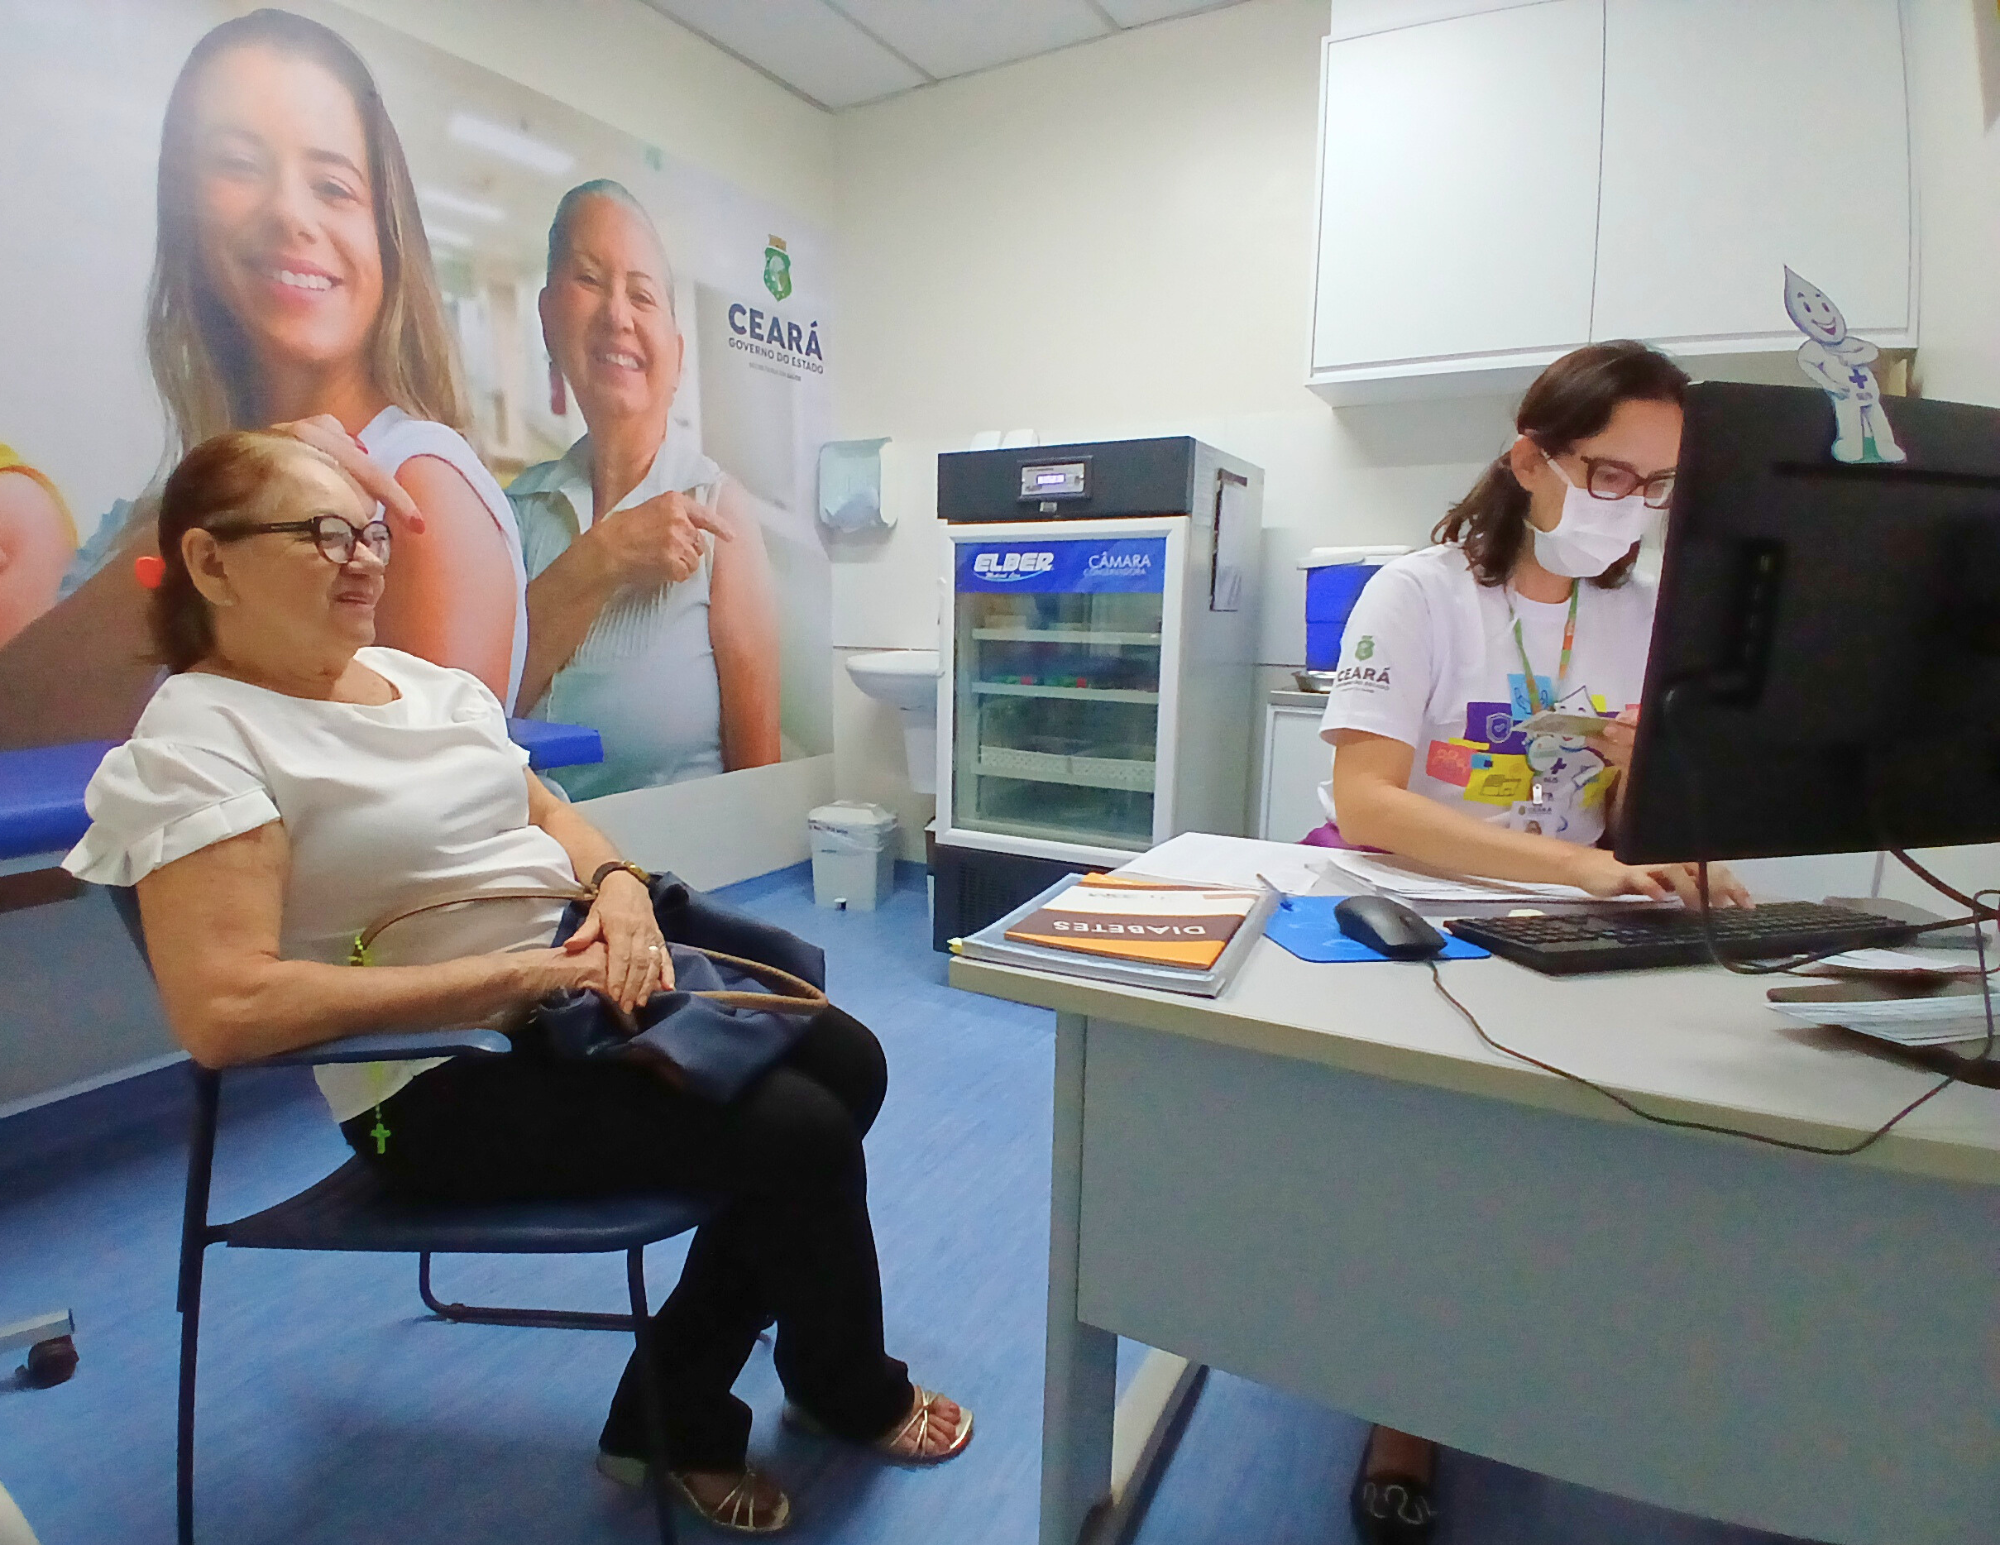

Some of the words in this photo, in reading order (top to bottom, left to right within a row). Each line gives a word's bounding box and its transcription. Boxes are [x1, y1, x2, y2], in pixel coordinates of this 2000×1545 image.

[728, 303, 823, 361] CEARÁ
[728, 337, 775, 360] GOVERNO
[776, 352, 790, 365] DO
[791, 356, 824, 375] ESTADO
[973, 552, 1055, 572] ELBER
[1088, 551, 1152, 569] CÂMARA
[1337, 666, 1391, 685] CEARÁ
[1052, 920, 1207, 936] DIABETES
